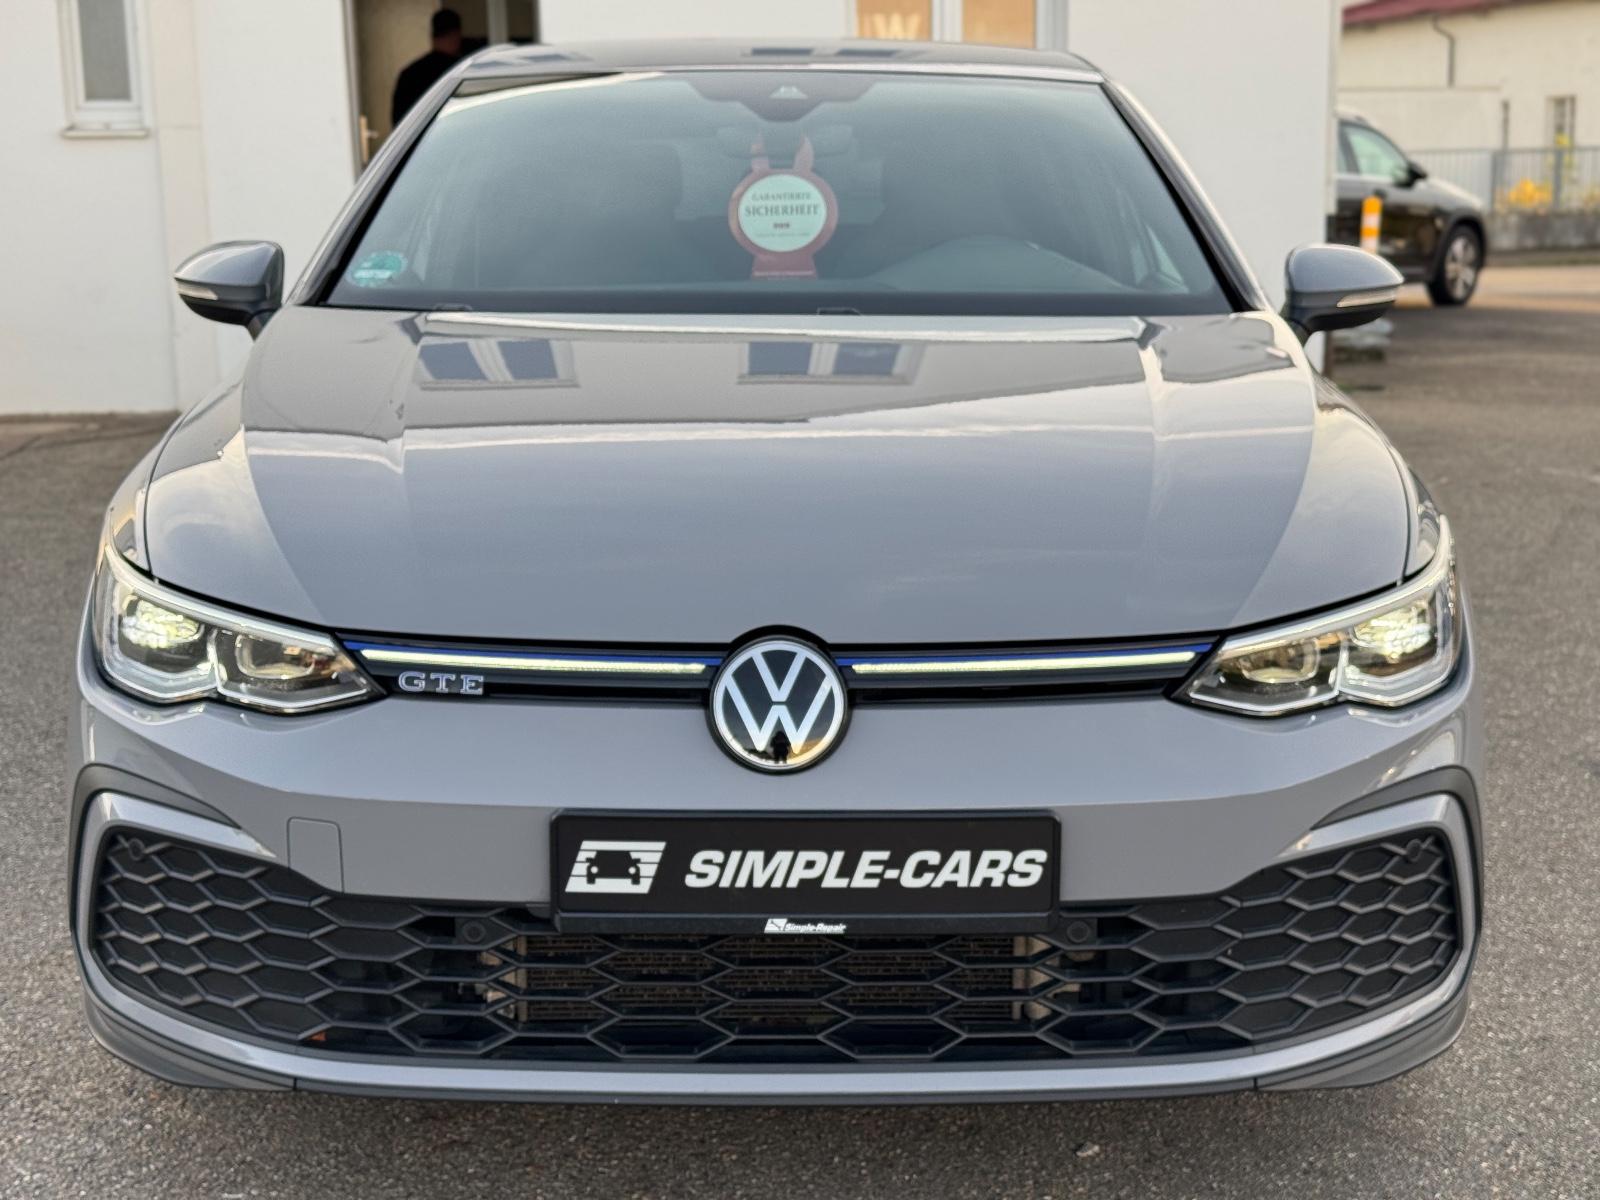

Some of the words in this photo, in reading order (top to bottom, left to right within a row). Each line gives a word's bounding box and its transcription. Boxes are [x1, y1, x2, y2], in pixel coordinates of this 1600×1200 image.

[745, 204, 819, 216] SICHERHEIT
[398, 670, 484, 695] GTE
[685, 850, 1047, 888] SIMPLE-CARS
[784, 923, 846, 933] Simple-Repair
